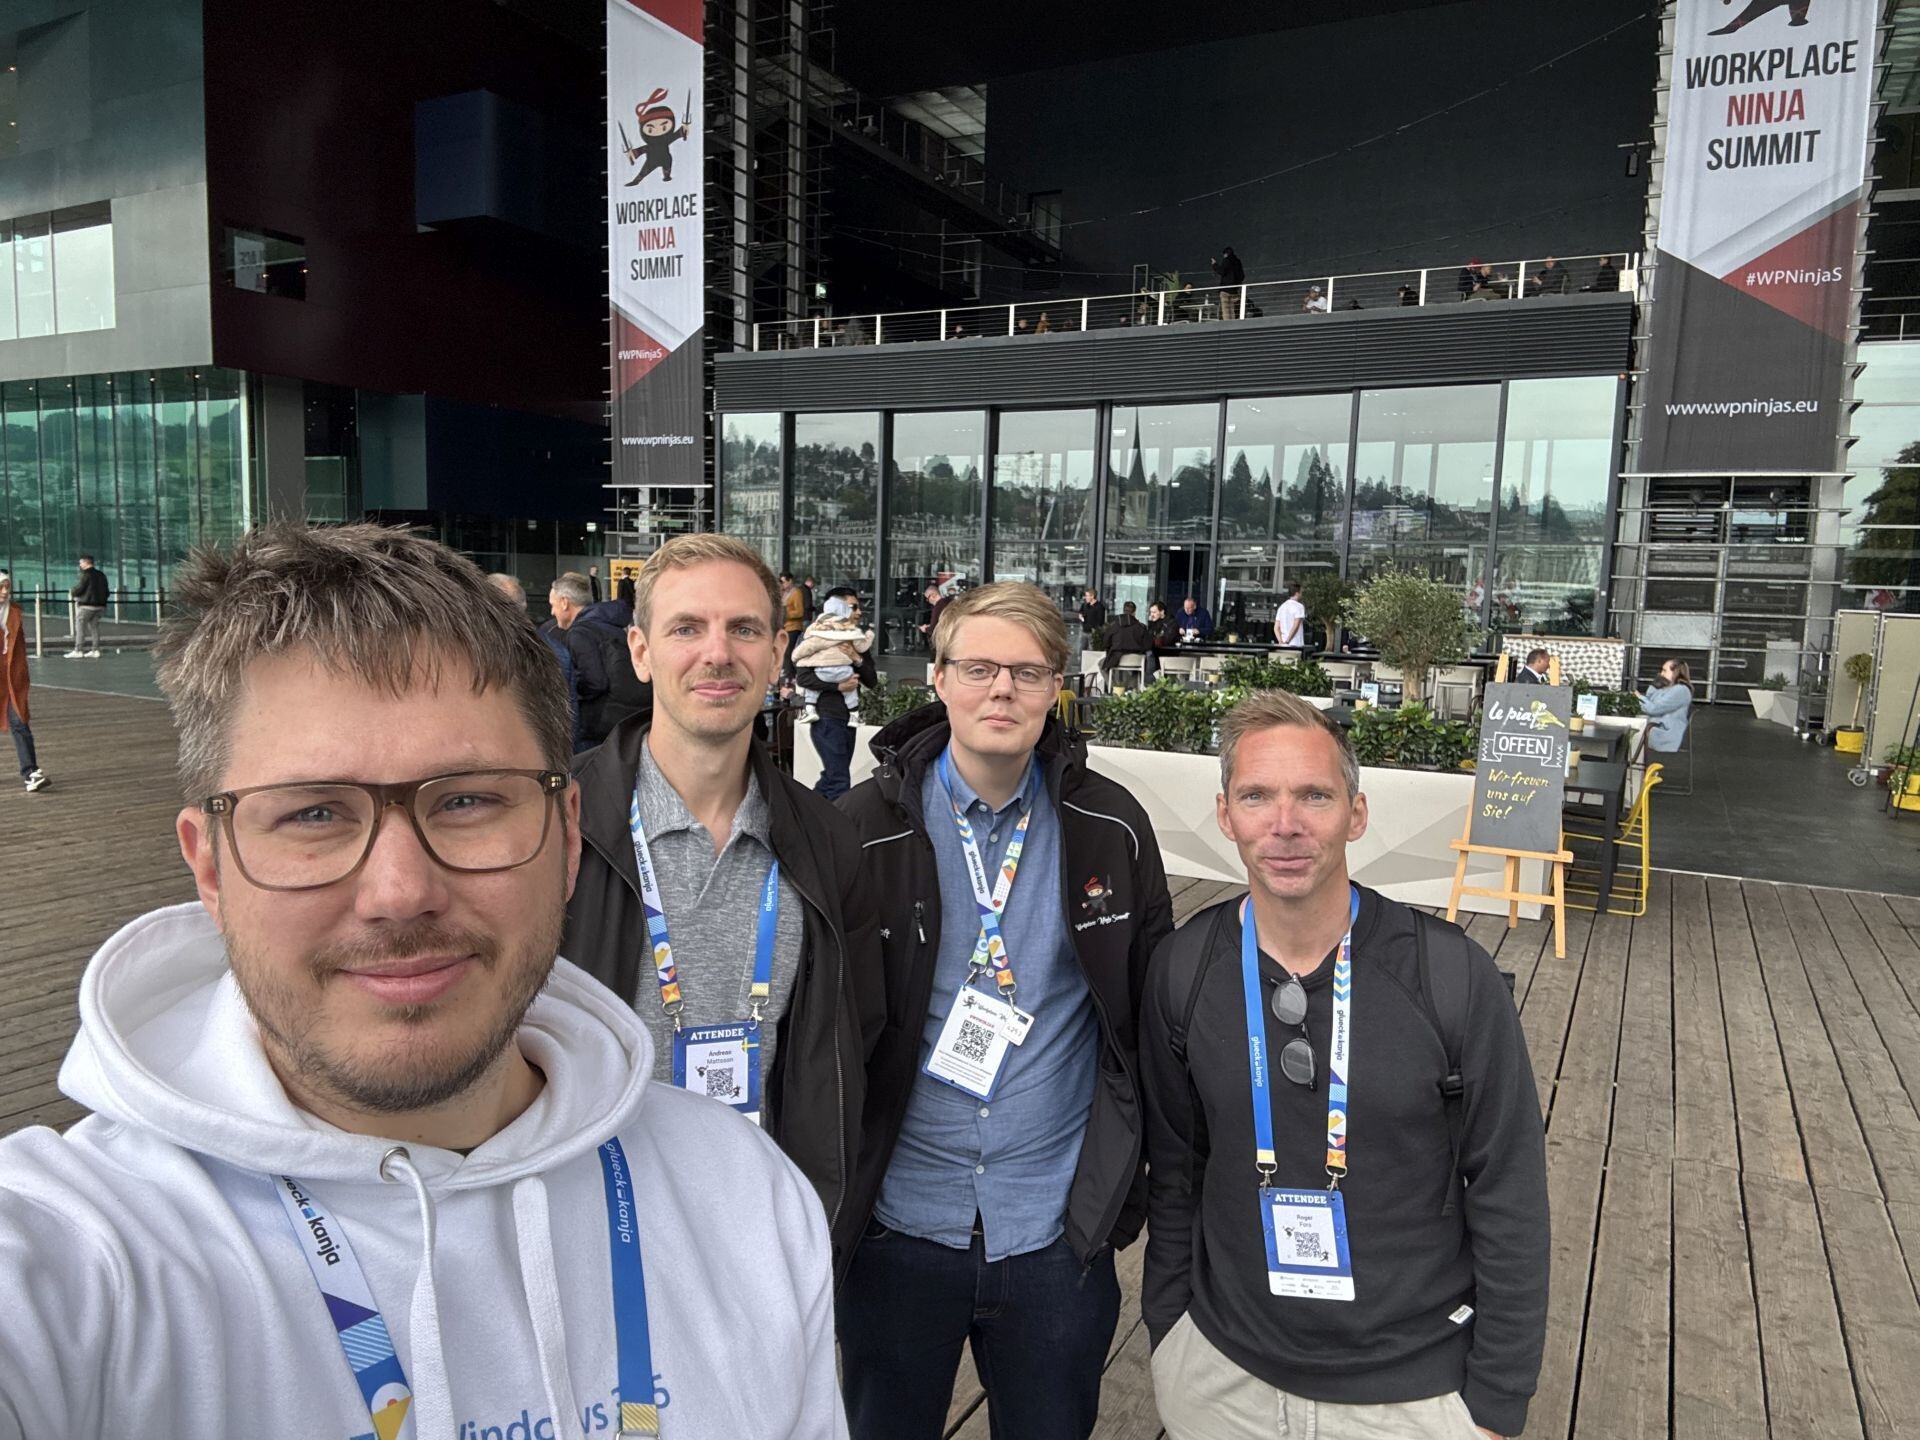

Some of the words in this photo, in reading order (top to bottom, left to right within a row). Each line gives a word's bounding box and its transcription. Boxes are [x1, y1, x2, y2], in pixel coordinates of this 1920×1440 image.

[1686, 40, 1858, 89] WORKPLACE
[1726, 89, 1805, 127] NINJA
[1706, 130, 1821, 170] SUMMIT
[616, 194, 697, 224] WORKPLACE
[638, 226, 676, 251] NINJA
[630, 254, 684, 281] SUMMIT
[1746, 267, 1843, 287] #WPNinjaS
[617, 346, 663, 362] #WPNinjaS
[1665, 398, 1819, 417] www.wpninjas.eu
[621, 433, 695, 447] www.wpninjas.eu
[1499, 736, 1548, 754] OFFEN
[1488, 769, 1511, 782] Wir
[1511, 771, 1549, 787] freuen
[1486, 788, 1508, 801] uns
[1511, 790, 1537, 806] auf
[1482, 803, 1513, 819] Sie!
[633, 840, 647, 865] glueck
[641, 870, 653, 893] kanja
[1337, 1009, 1346, 1034] glueck
[690, 1027, 745, 1041] ATTENDEE
[1250, 1036, 1262, 1061] glueck
[1335, 1040, 1345, 1061] kanja
[1254, 1066, 1264, 1088] kanja
[604, 1143, 627, 1187] glueck
[617, 1201, 634, 1244] kanja
[1274, 1193, 1328, 1204] ATTENDEE
[281, 1175, 310, 1209] ueck
[307, 1216, 341, 1266] kanja
